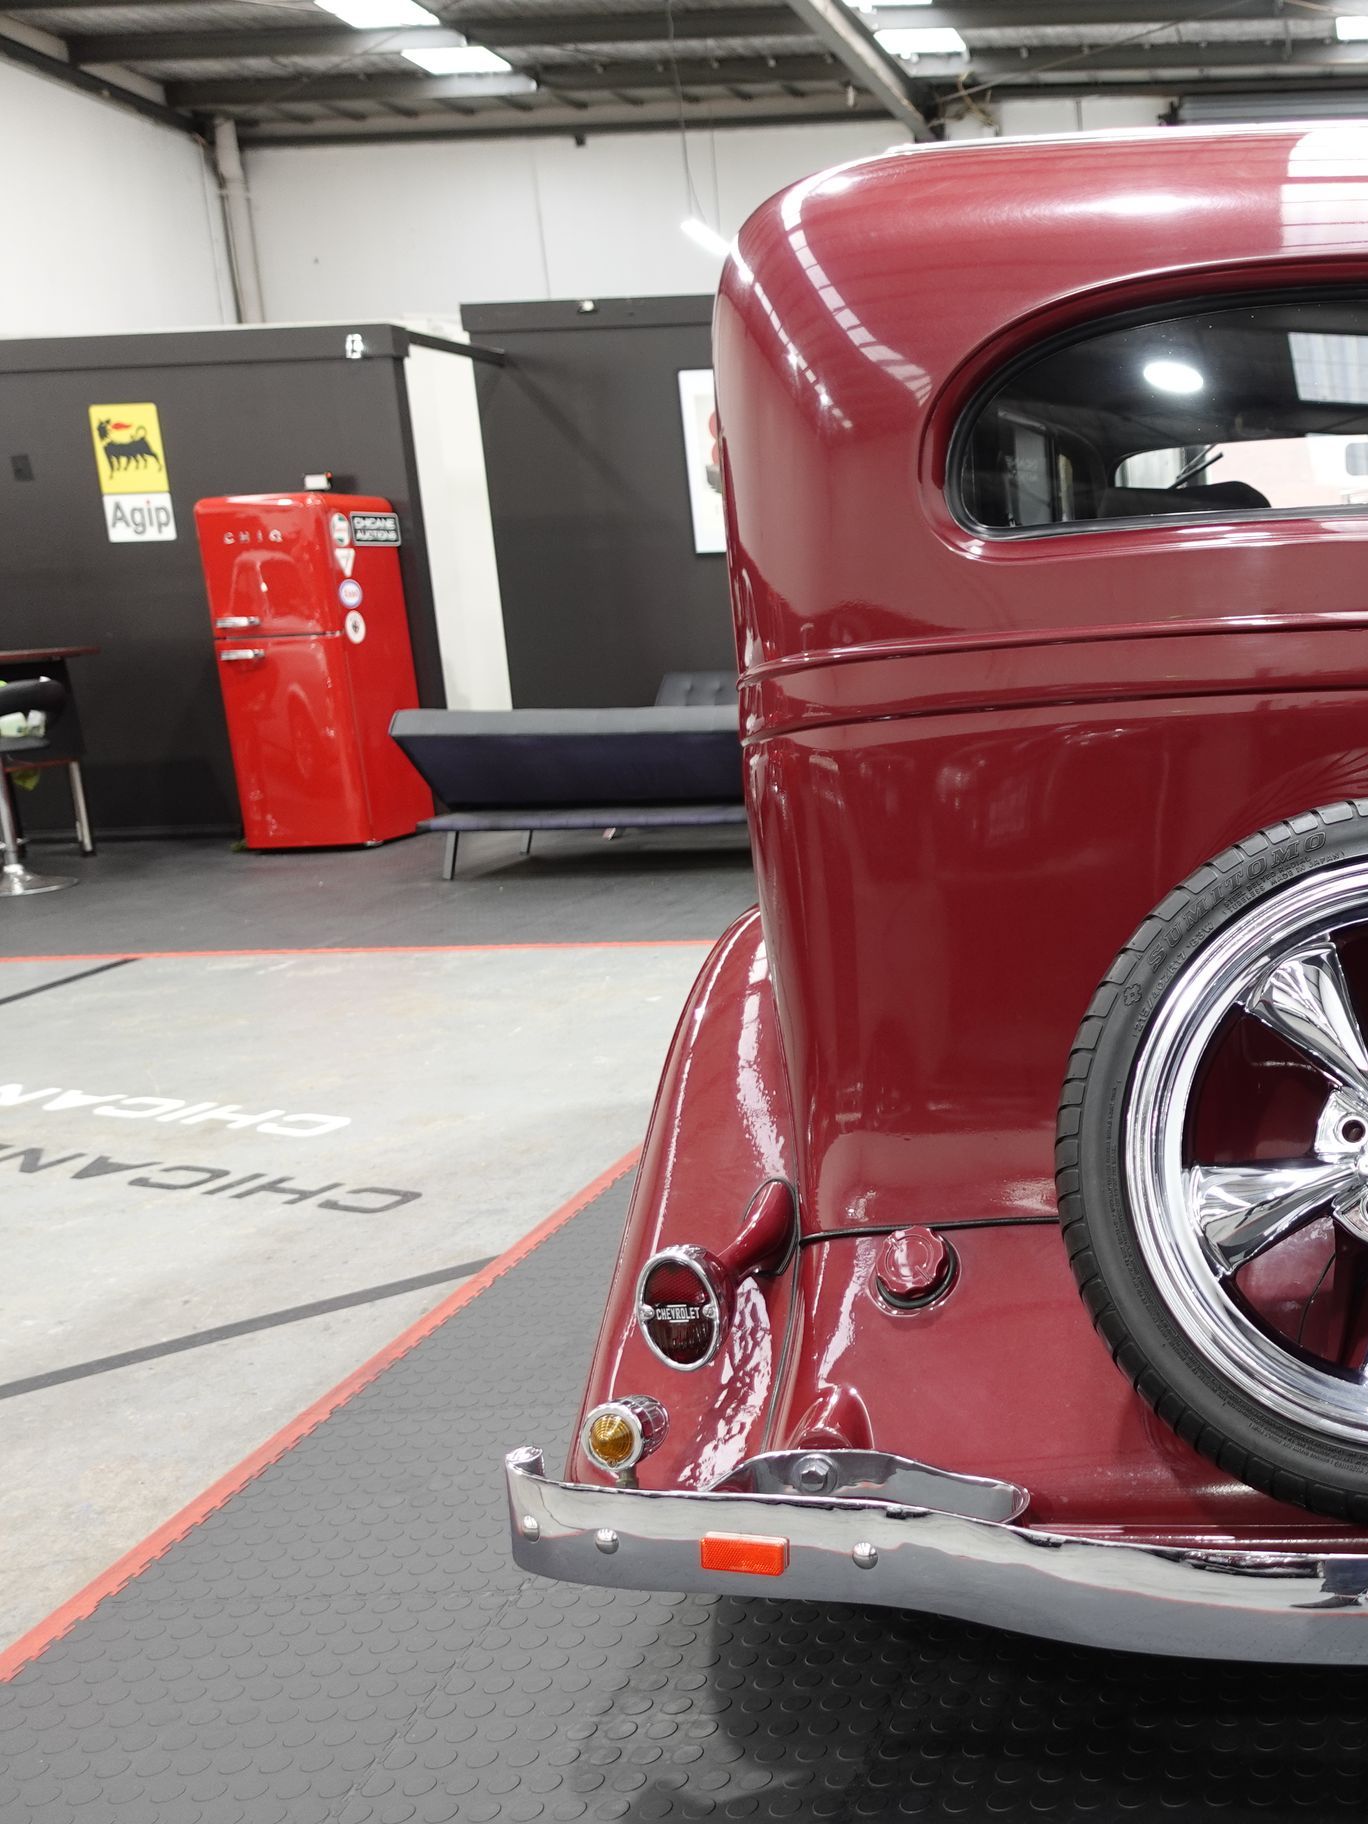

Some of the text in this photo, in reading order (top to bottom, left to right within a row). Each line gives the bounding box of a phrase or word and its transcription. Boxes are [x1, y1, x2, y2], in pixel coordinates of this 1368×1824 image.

[111, 499, 171, 535] Agip
[1147, 831, 1326, 974] SUMITOMO
[0, 1144, 423, 1214] CHICAN
[655, 1307, 700, 1320] CHEVROLET
